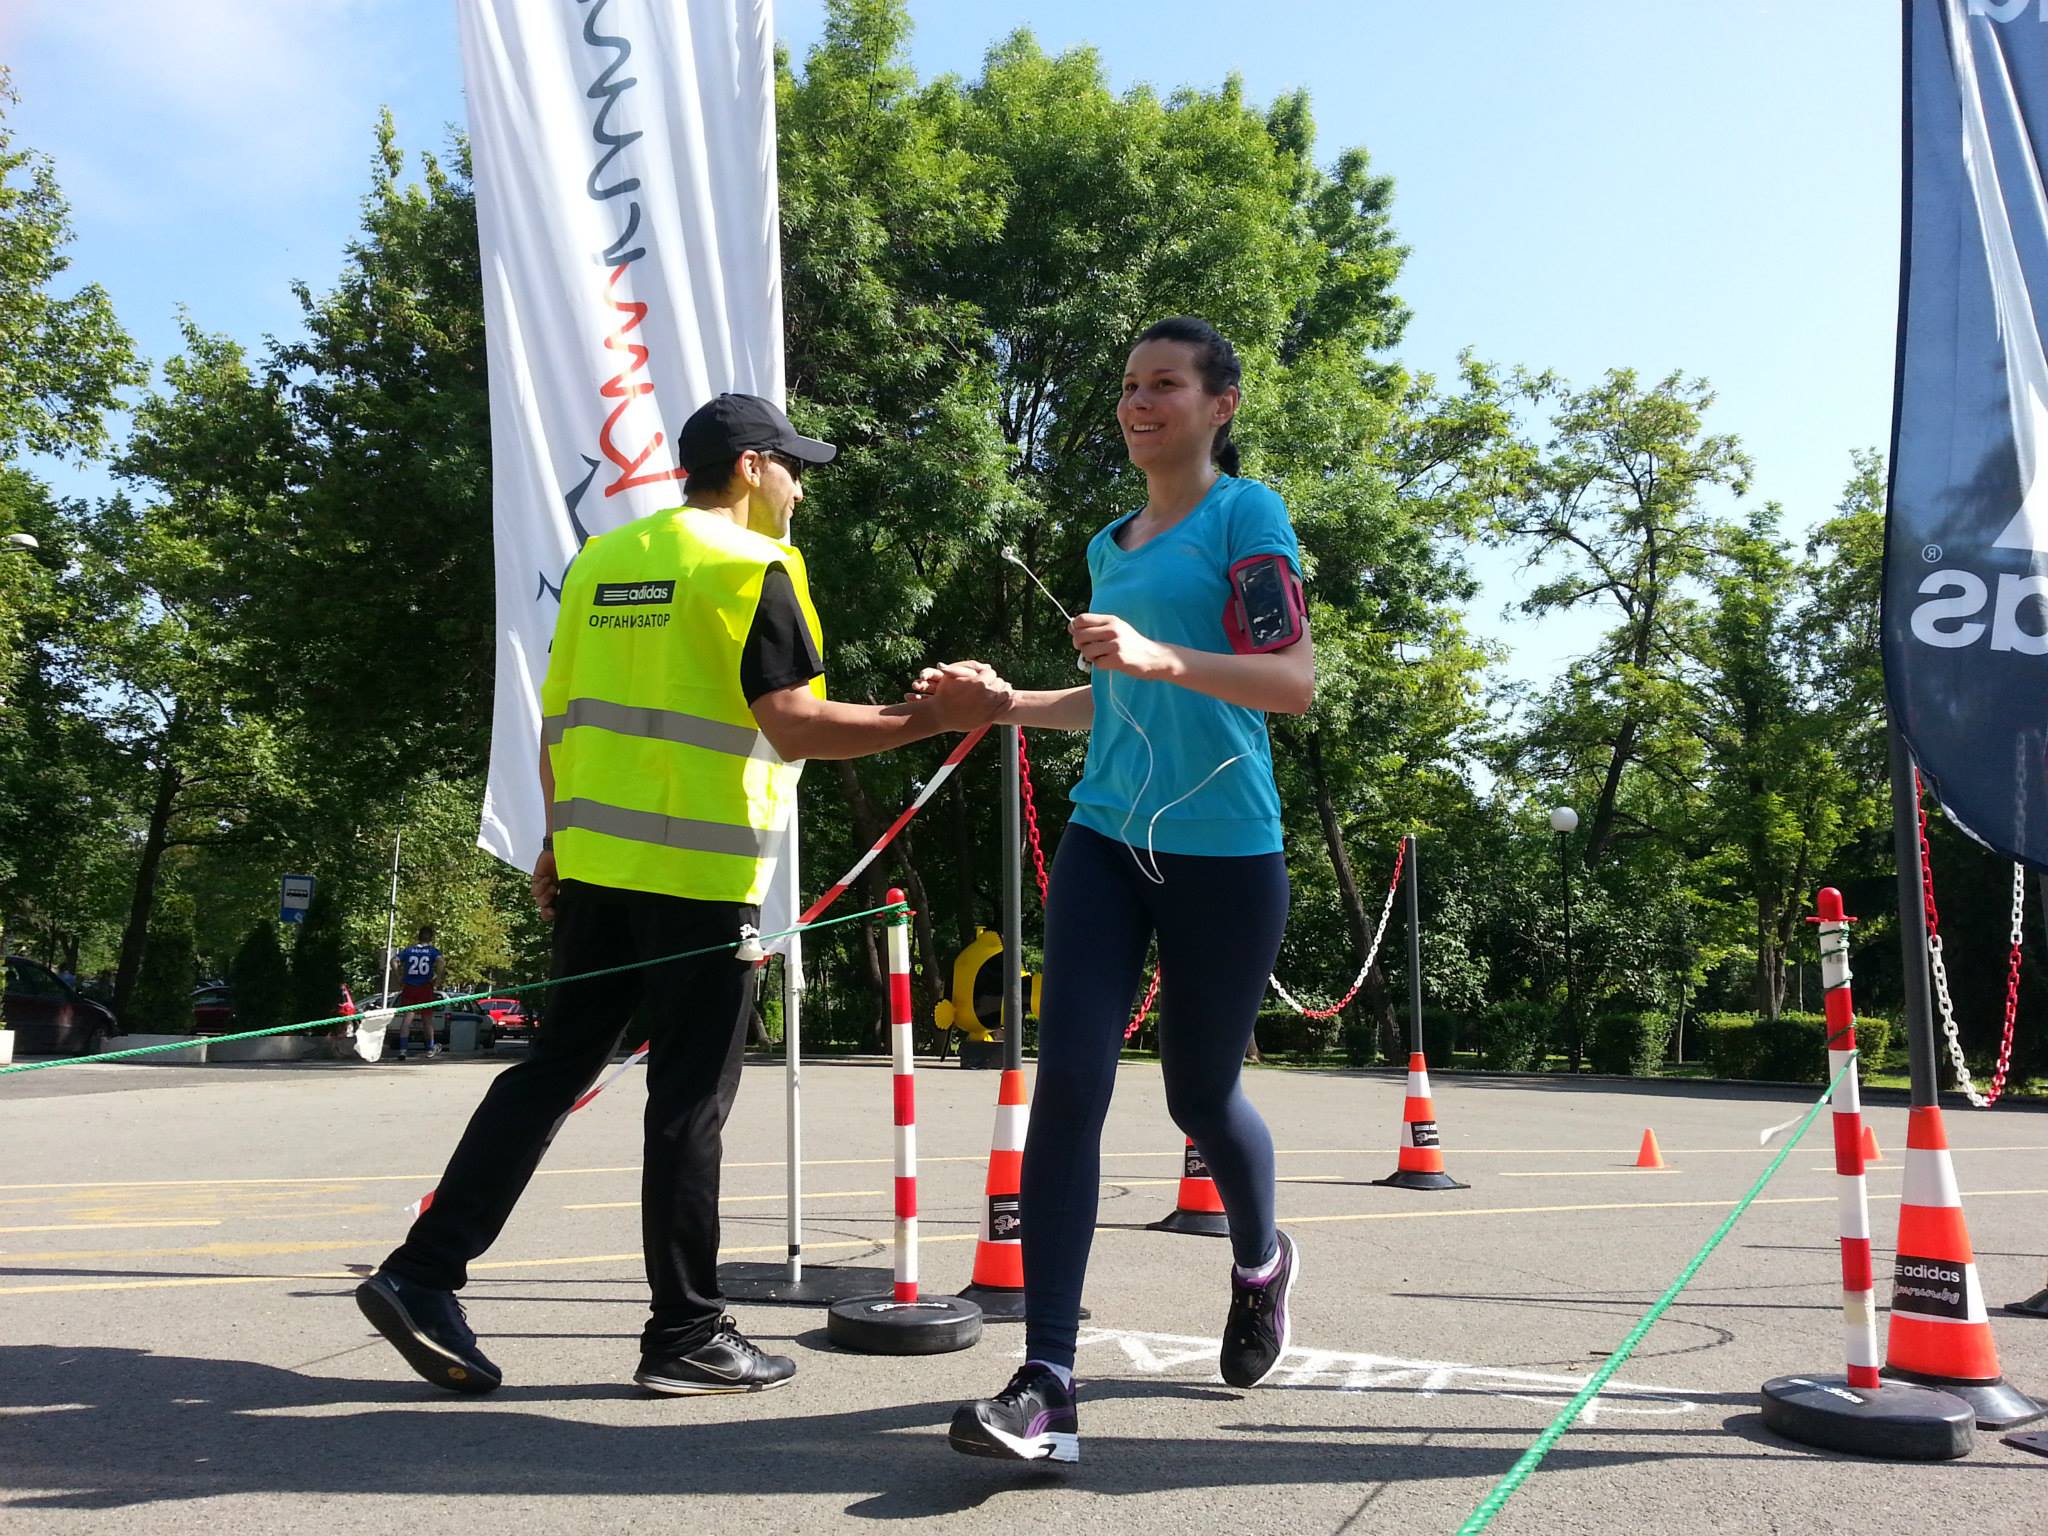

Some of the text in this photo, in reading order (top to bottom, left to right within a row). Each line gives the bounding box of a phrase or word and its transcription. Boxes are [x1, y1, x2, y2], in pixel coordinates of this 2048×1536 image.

[628, 585, 668, 600] adidas
[588, 613, 671, 628] ОРГАНИЗАТОР
[408, 955, 430, 975] 26
[1903, 1264, 1960, 1282] adidas
